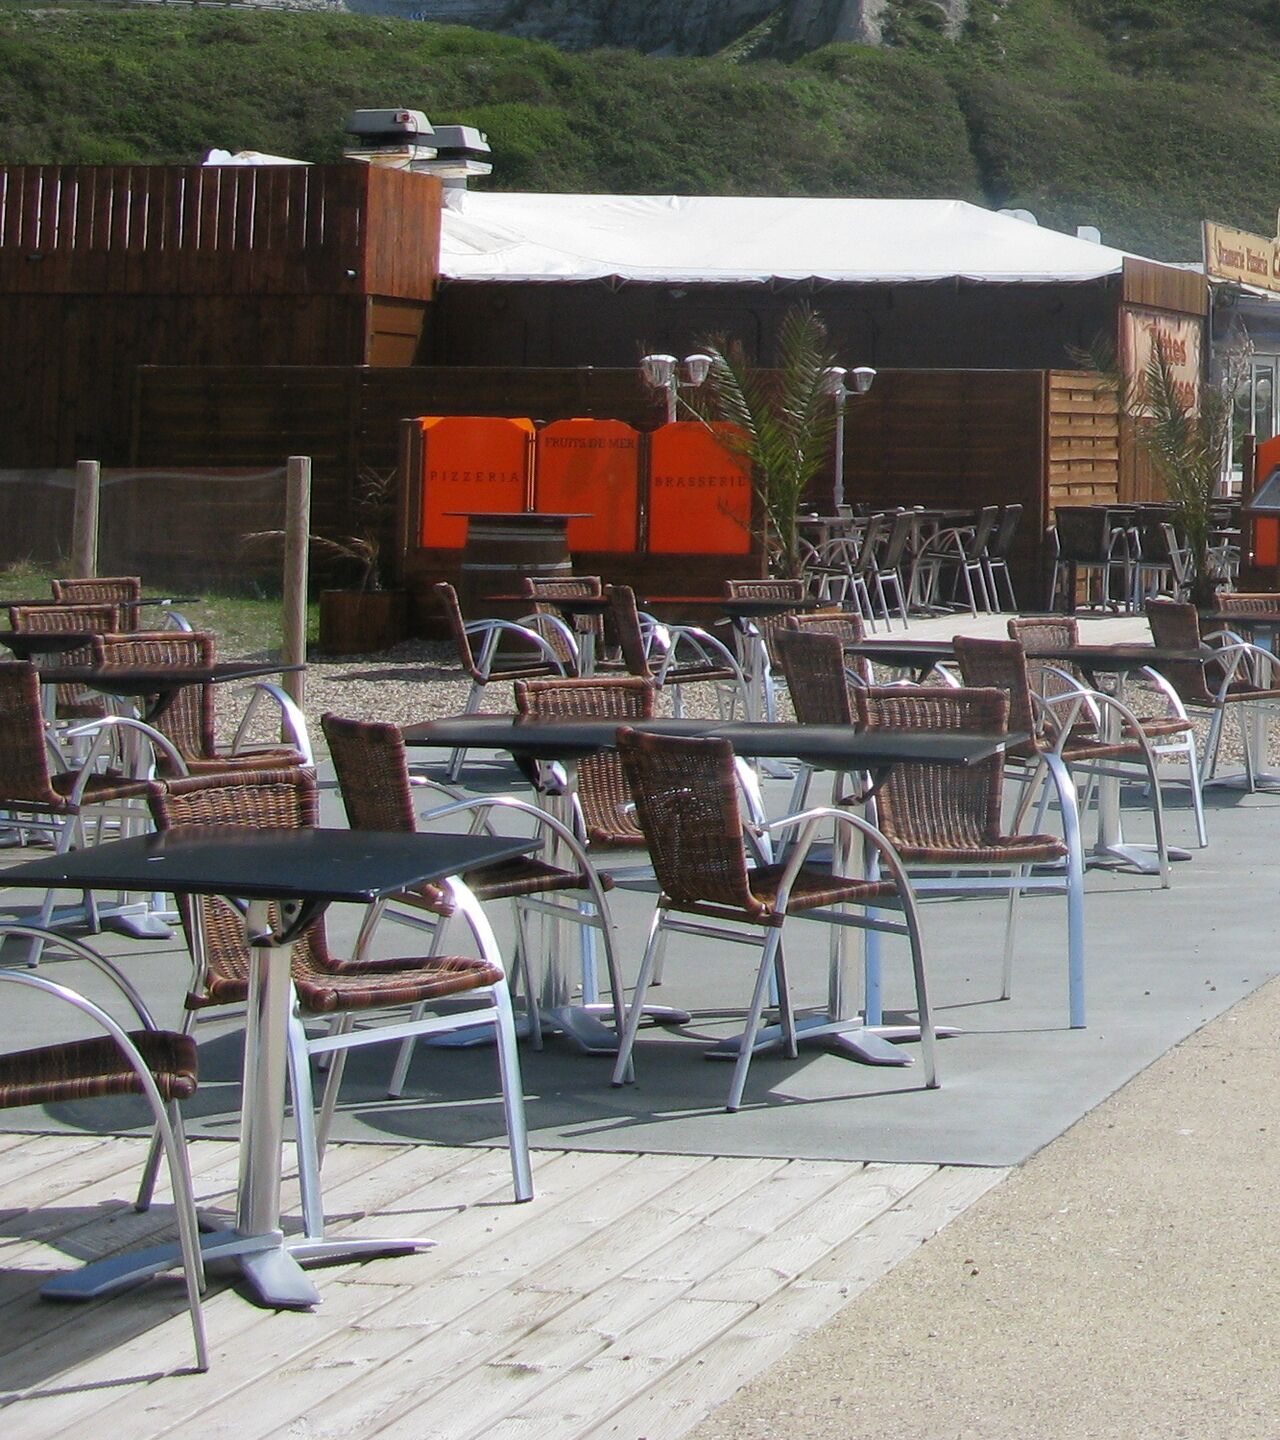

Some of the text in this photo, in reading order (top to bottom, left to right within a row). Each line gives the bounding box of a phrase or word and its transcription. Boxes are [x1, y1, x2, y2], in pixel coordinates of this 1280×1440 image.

[545, 437, 635, 449] FRUITS DE MER
[430, 471, 520, 483] PIZZERIA
[654, 476, 747, 488] BRASSERIE
